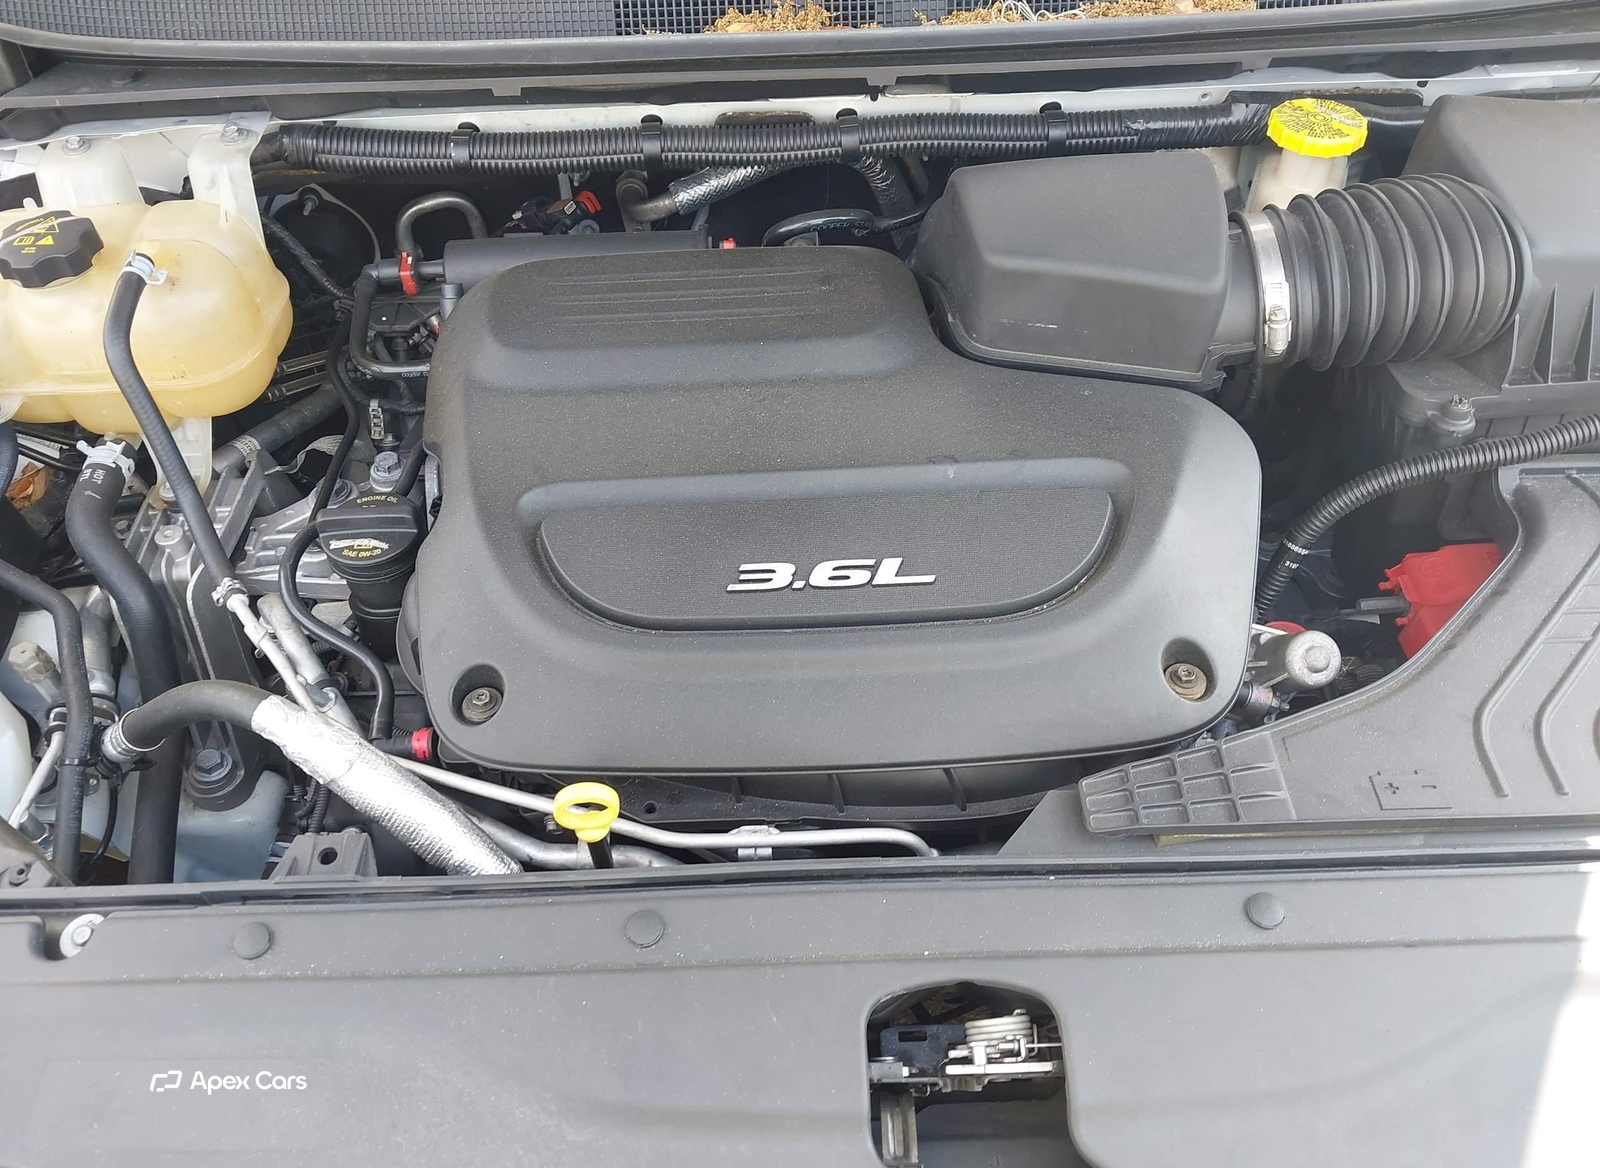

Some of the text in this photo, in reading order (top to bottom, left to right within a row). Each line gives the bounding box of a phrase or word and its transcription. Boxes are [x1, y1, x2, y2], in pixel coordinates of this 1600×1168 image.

[356, 495, 399, 504] ENGINE OIL
[341, 548, 382, 558] SAE 0W-20
[726, 557, 937, 593] 3.6L
